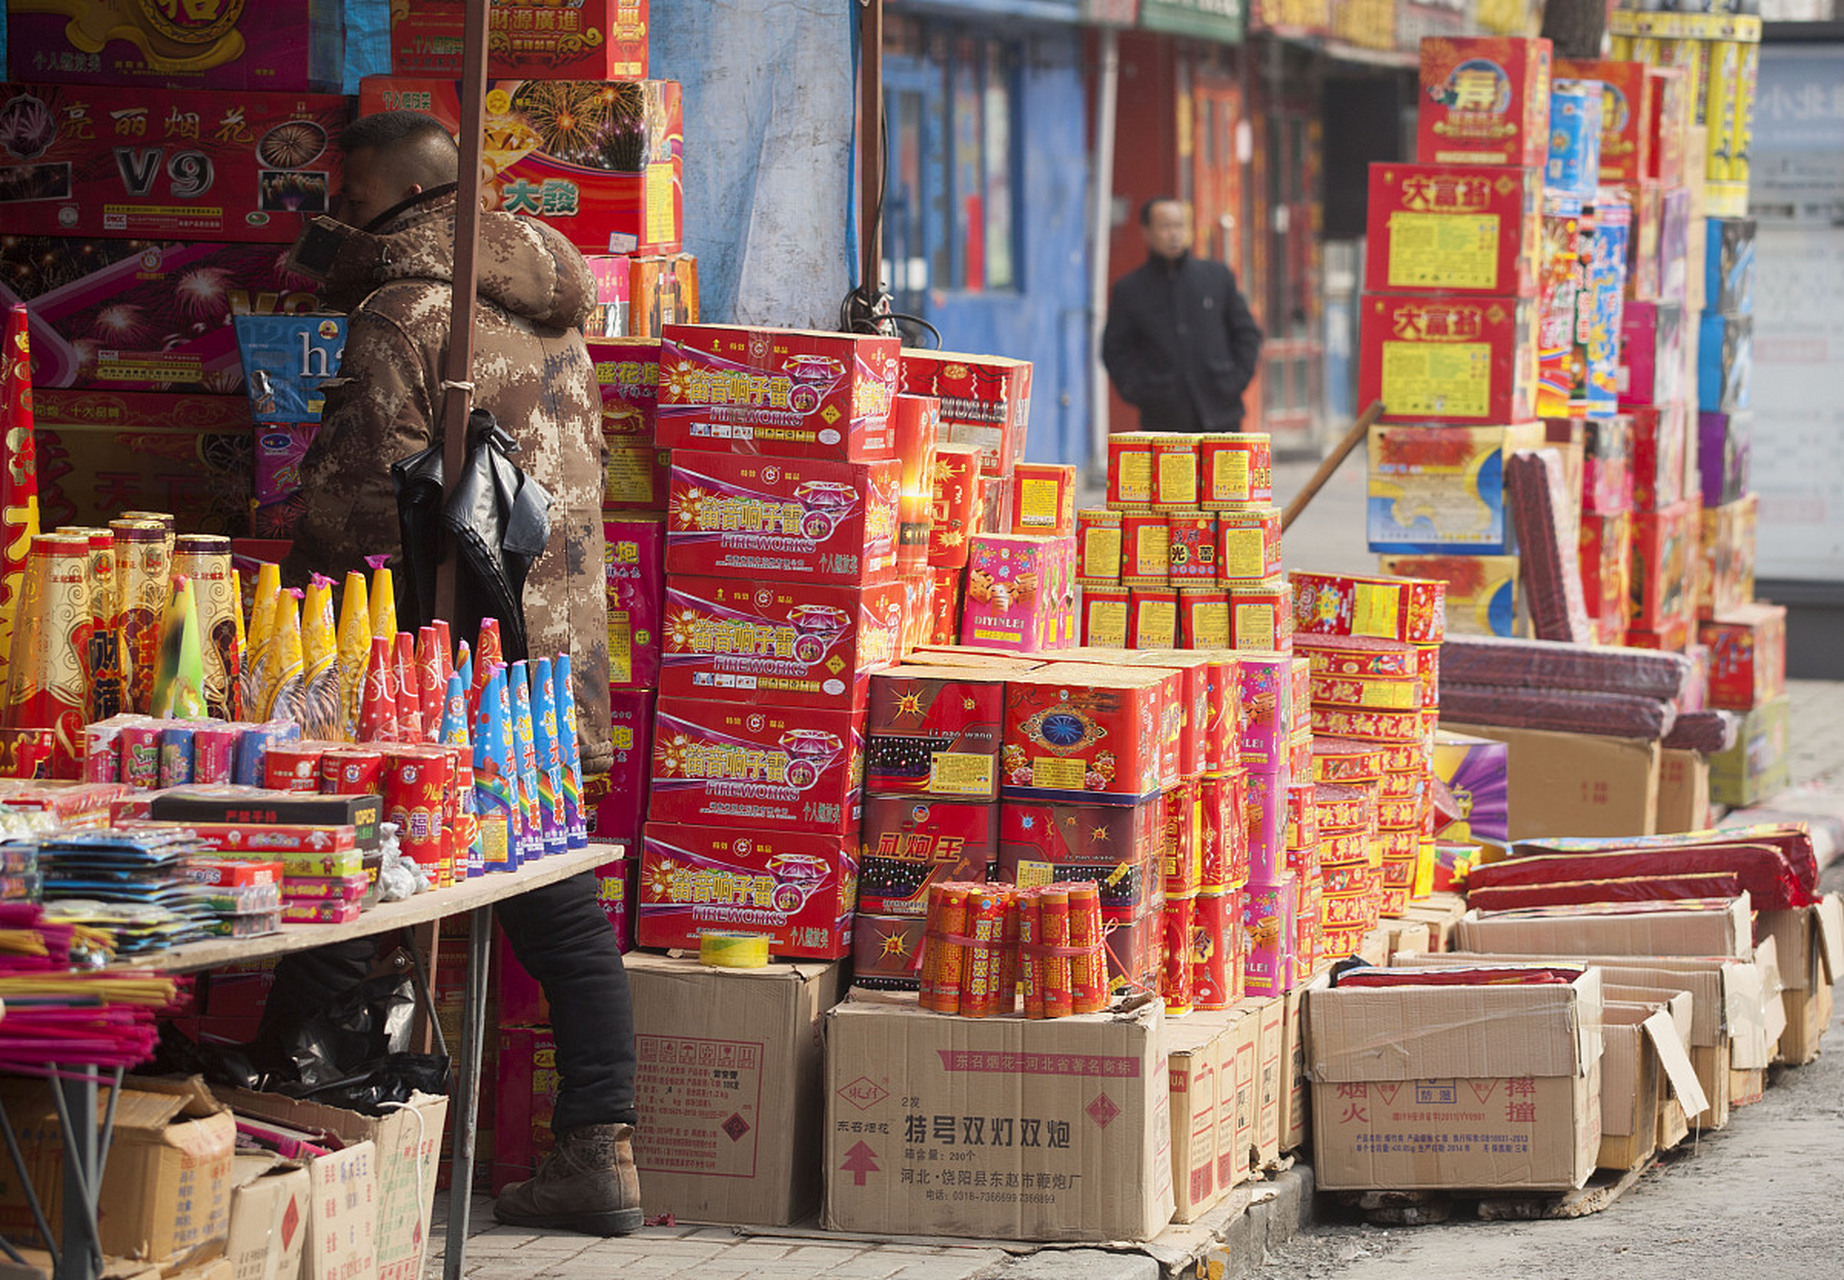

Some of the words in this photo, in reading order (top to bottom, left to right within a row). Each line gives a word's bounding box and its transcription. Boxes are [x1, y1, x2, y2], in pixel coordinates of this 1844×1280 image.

[489, 8, 580, 32] 財源廣進
[60, 101, 254, 144] 亮丽烟花
[113, 147, 215, 198] V9
[502, 178, 581, 217] 大發
[720, 533, 817, 554] FIREWORKS
[974, 615, 1026, 630] DIYINLEI
[713, 655, 809, 677] FIREWORKS
[705, 781, 801, 802] FIREWORKS
[877, 832, 965, 861] 礼炮王
[692, 905, 788, 926] FIREWORKS
[904, 1113, 1071, 1150] 特号双灯双炮
